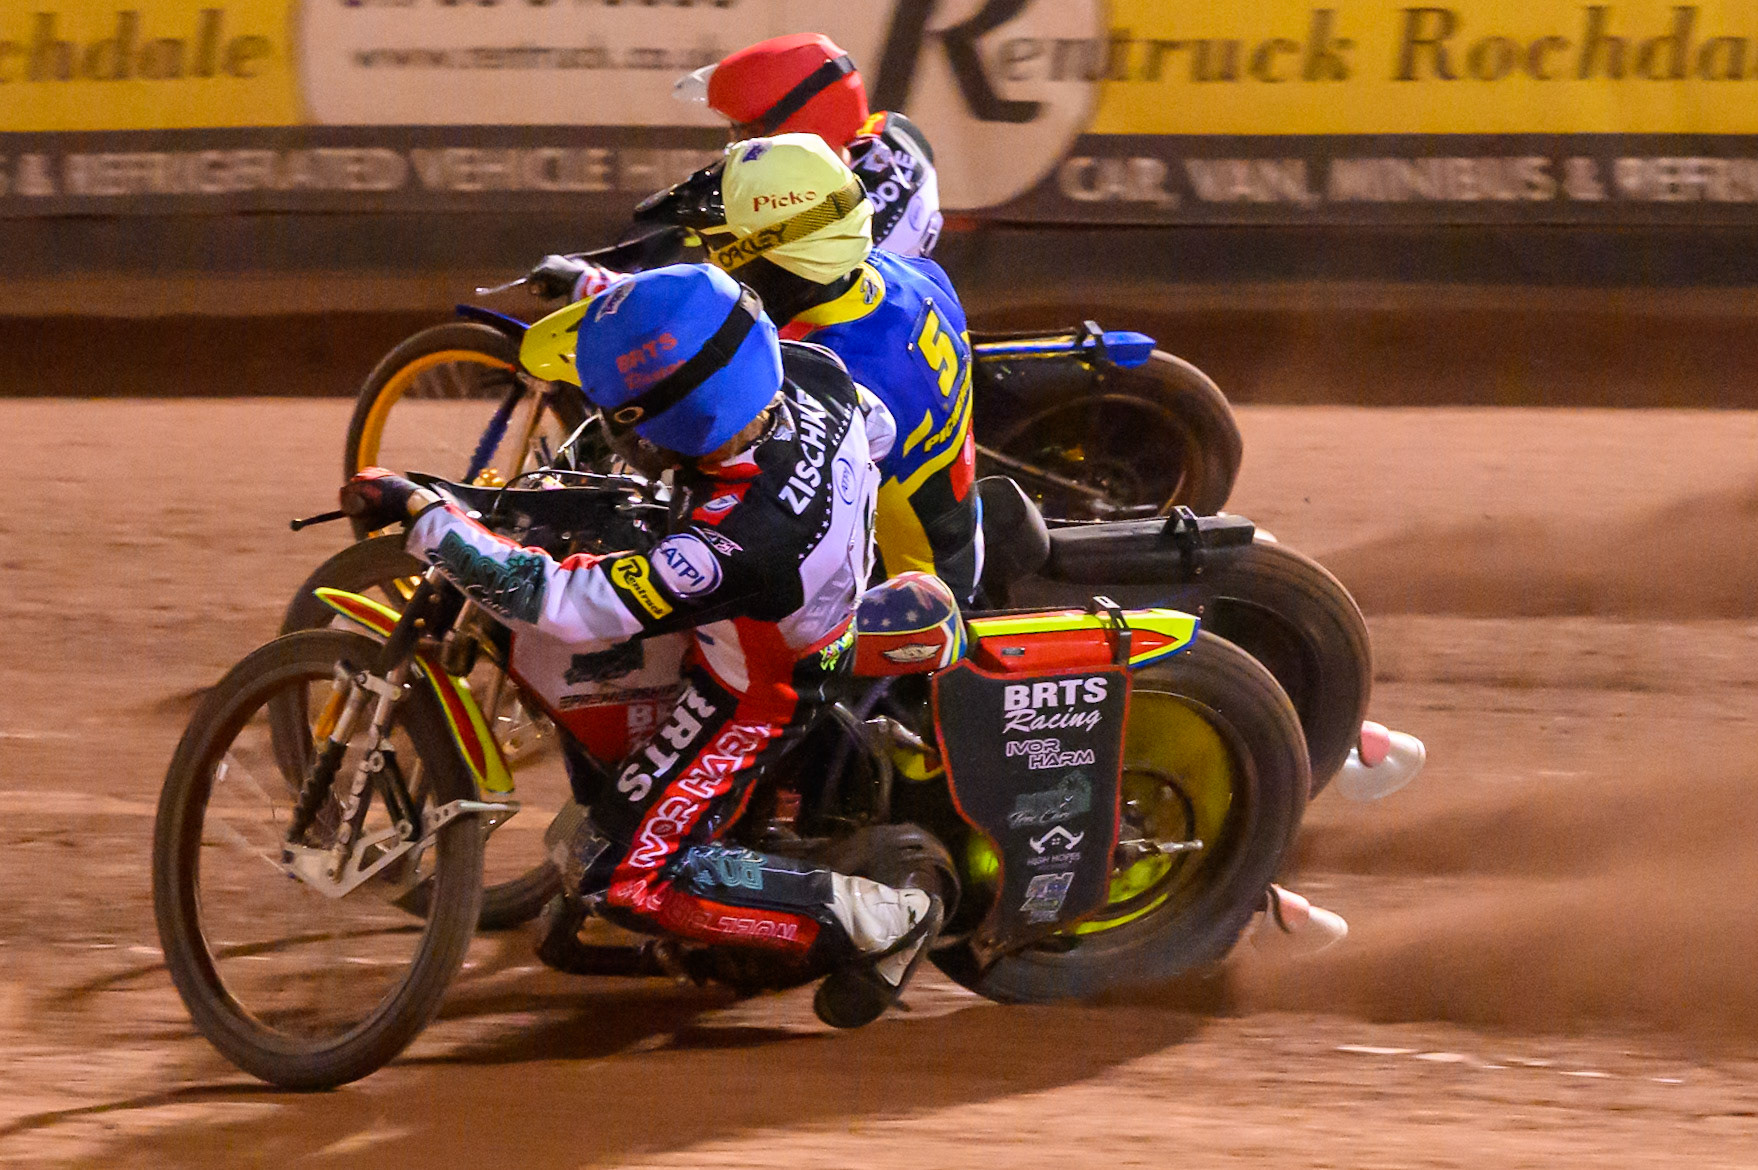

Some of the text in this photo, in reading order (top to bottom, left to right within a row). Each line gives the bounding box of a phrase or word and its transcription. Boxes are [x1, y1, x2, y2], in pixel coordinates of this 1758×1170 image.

[752, 189, 818, 213] Picko
[917, 309, 959, 398] 5
[661, 547, 707, 587] ATPI
[616, 558, 665, 619] Rentruck
[1003, 676, 1109, 711] BRTS
[1002, 706, 1103, 734] Racing
[1005, 738, 1060, 758] IVOR
[1028, 748, 1096, 770] HARM
